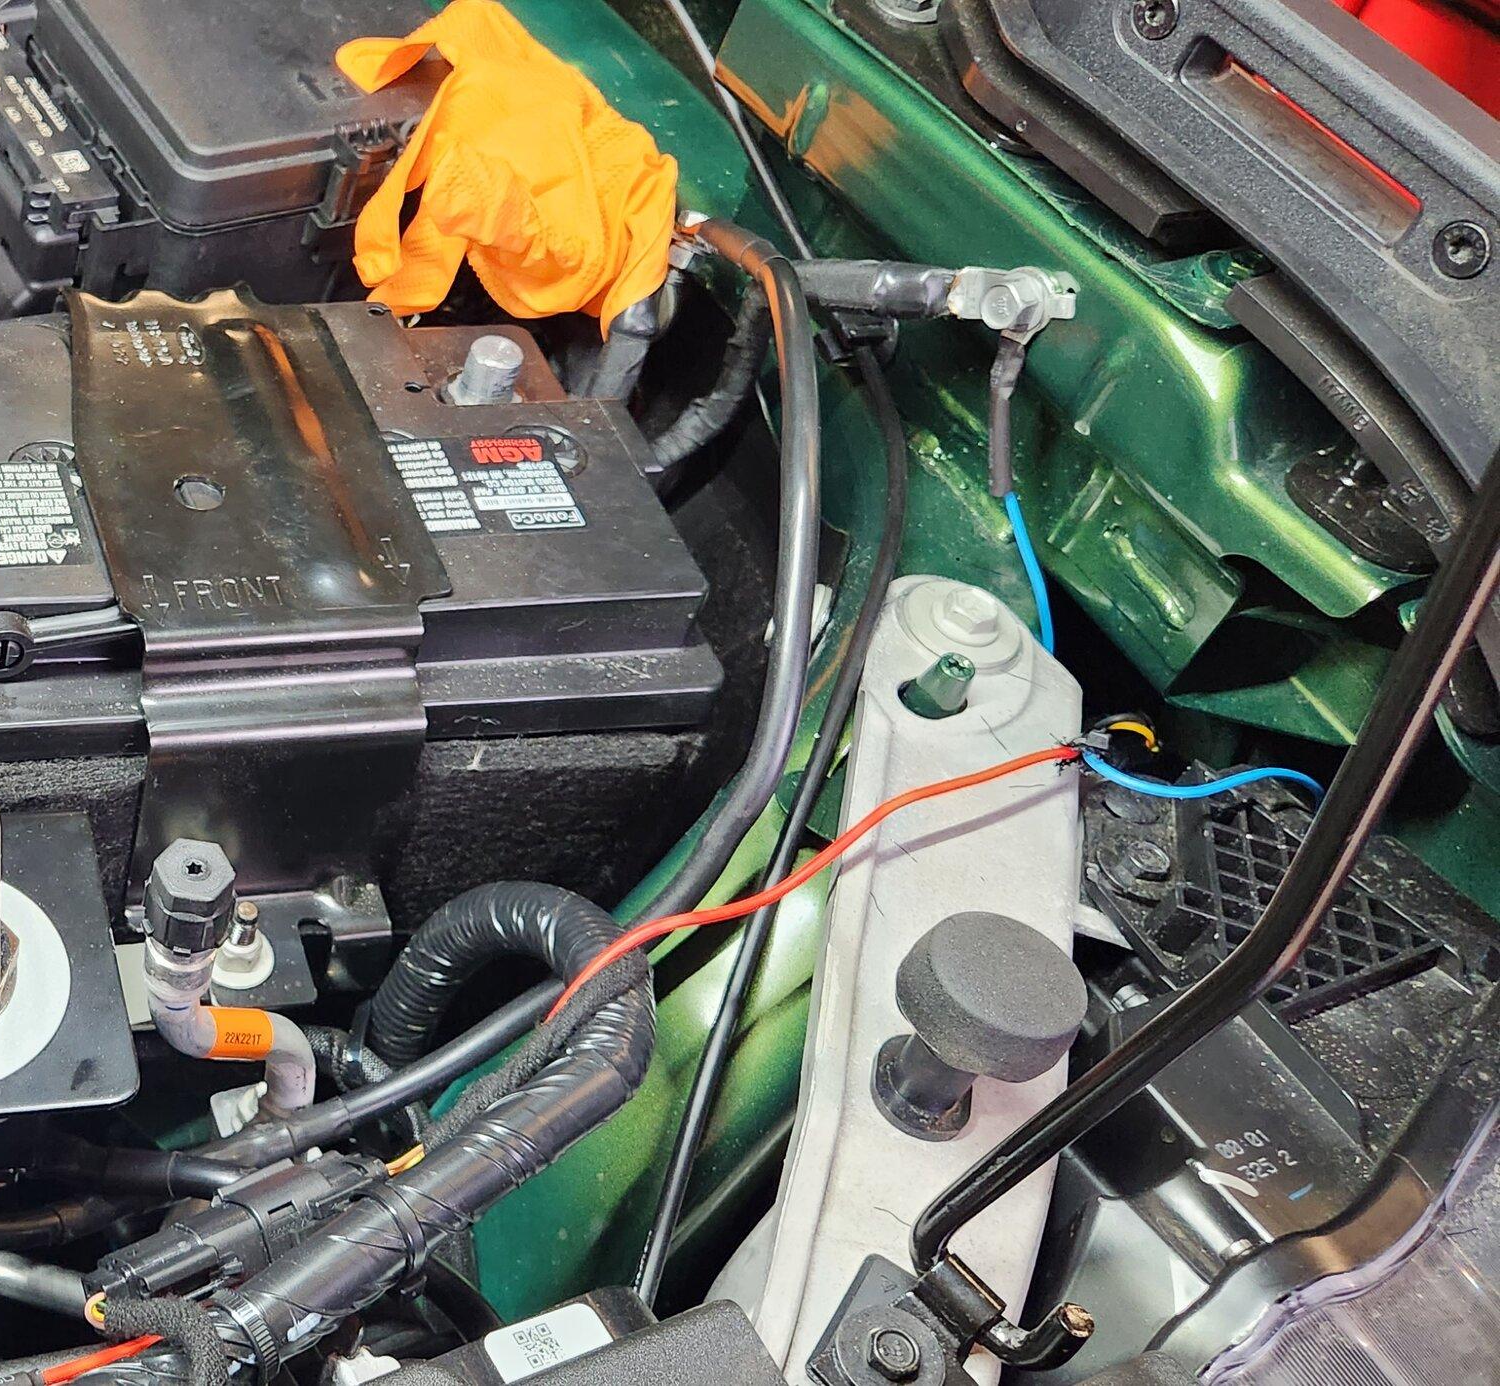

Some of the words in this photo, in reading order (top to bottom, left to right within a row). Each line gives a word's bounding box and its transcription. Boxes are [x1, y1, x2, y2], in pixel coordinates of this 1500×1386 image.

[470, 438, 539, 447] TECHNOLOGY
[472, 446, 542, 464] AGM
[1, 464, 30, 472] OUVRIR
[31, 464, 46, 472] PAS
[46, 464, 57, 472] NE
[15, 472, 36, 480] HORS
[37, 472, 60, 480] TENIR
[3, 480, 17, 488] THE
[17, 480, 27, 488] OF
[44, 479, 62, 487] KEEP
[501, 478, 535, 486] MOTOR
[18, 508, 32, 516] LES
[34, 515, 73, 524] BLINDNESS
[511, 510, 579, 524] FoMoCo
[12, 526, 26, 534] CAN
[1, 533, 46, 542] EXPLOSIVE
[173, 575, 282, 611] FRONT
[1214, 1129, 1270, 1160] 00:01
